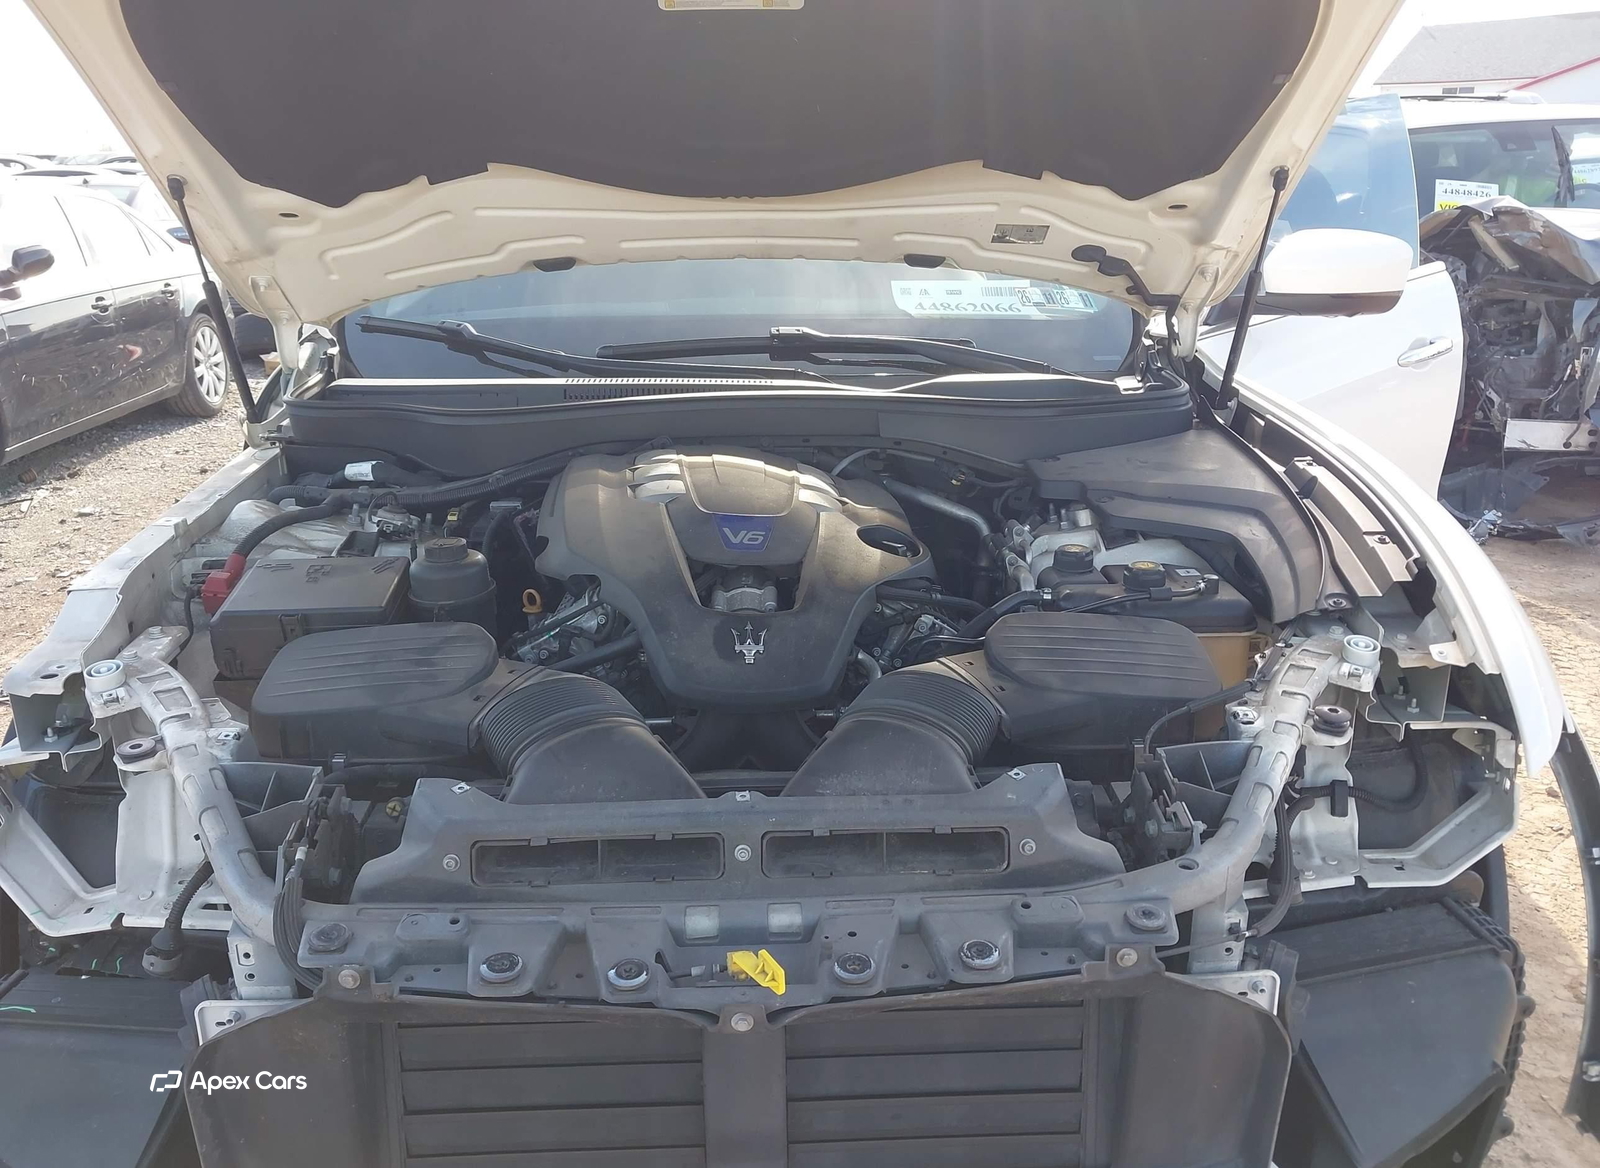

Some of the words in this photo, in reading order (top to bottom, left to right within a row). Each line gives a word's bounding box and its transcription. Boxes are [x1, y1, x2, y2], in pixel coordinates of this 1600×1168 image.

[1442, 188, 1491, 198] 44848426
[914, 302, 1022, 313] 44862066
[722, 527, 766, 545] V6
